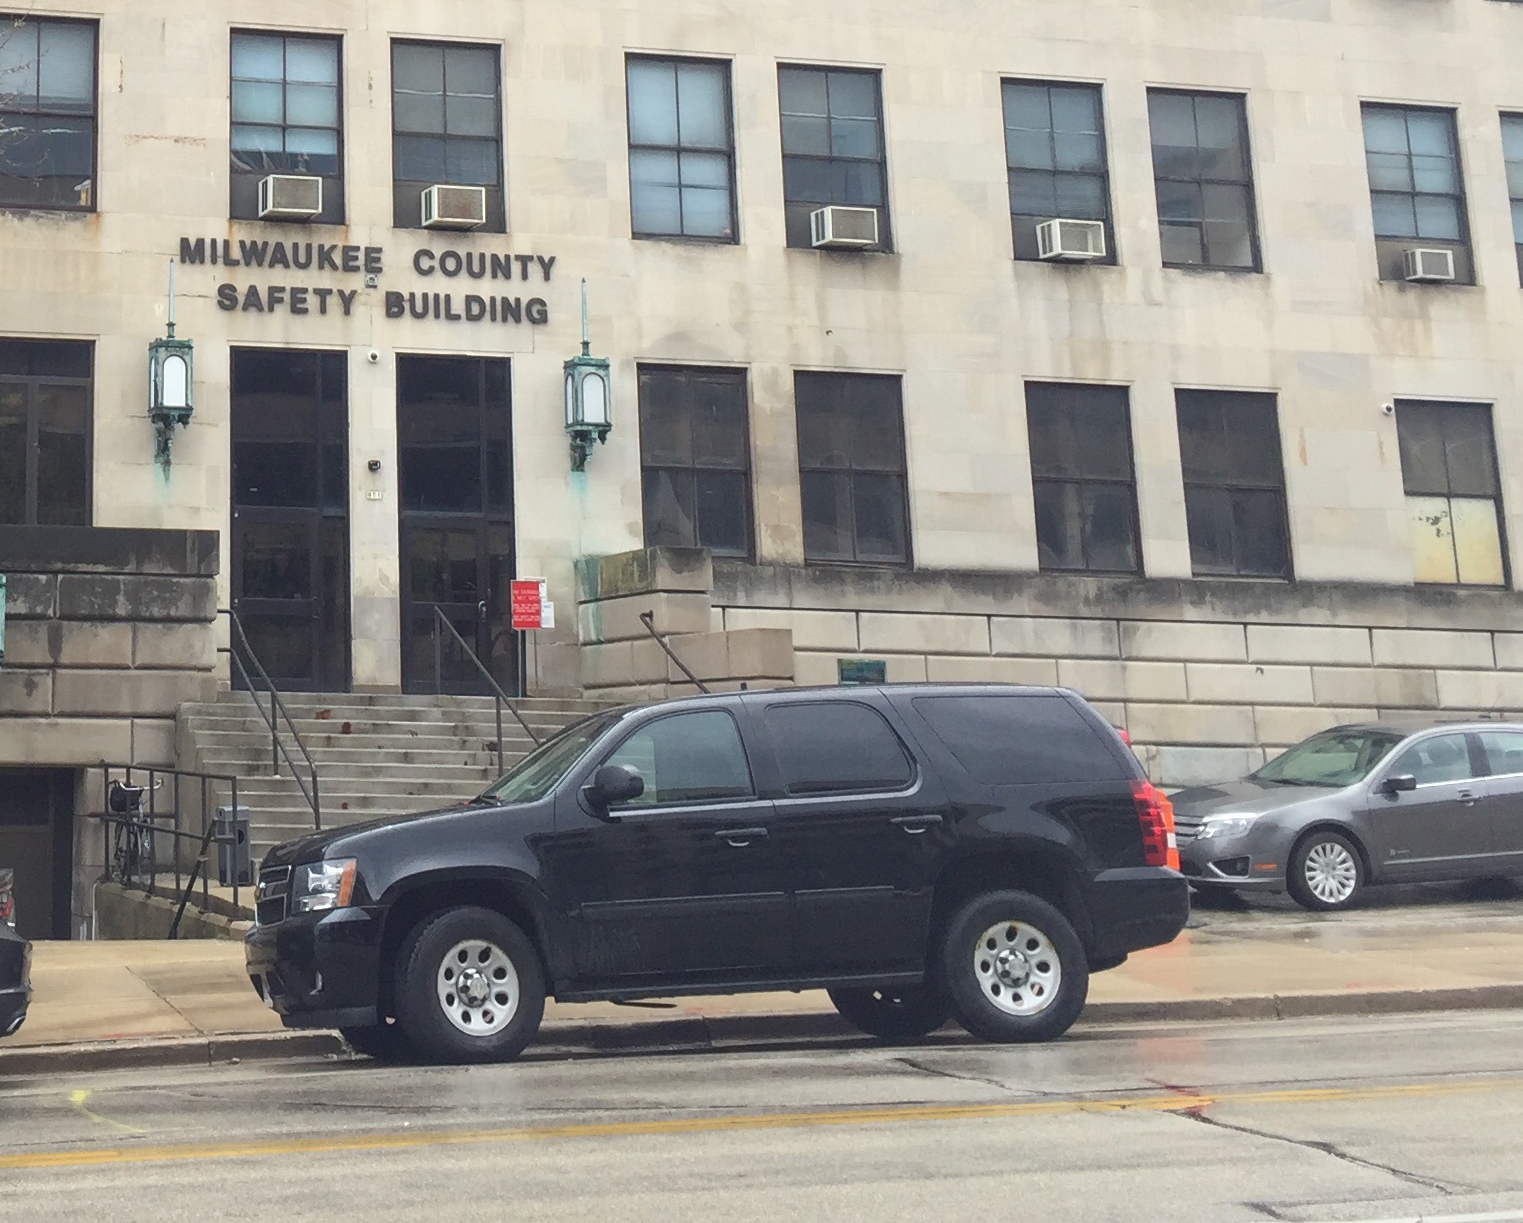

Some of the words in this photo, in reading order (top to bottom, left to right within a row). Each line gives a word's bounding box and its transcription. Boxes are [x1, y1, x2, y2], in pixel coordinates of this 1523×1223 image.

[179, 236, 383, 274] MILWAUKEE
[413, 248, 557, 282] COUNTY
[216, 282, 358, 317] SAFETY
[385, 290, 548, 325] BUILDING
